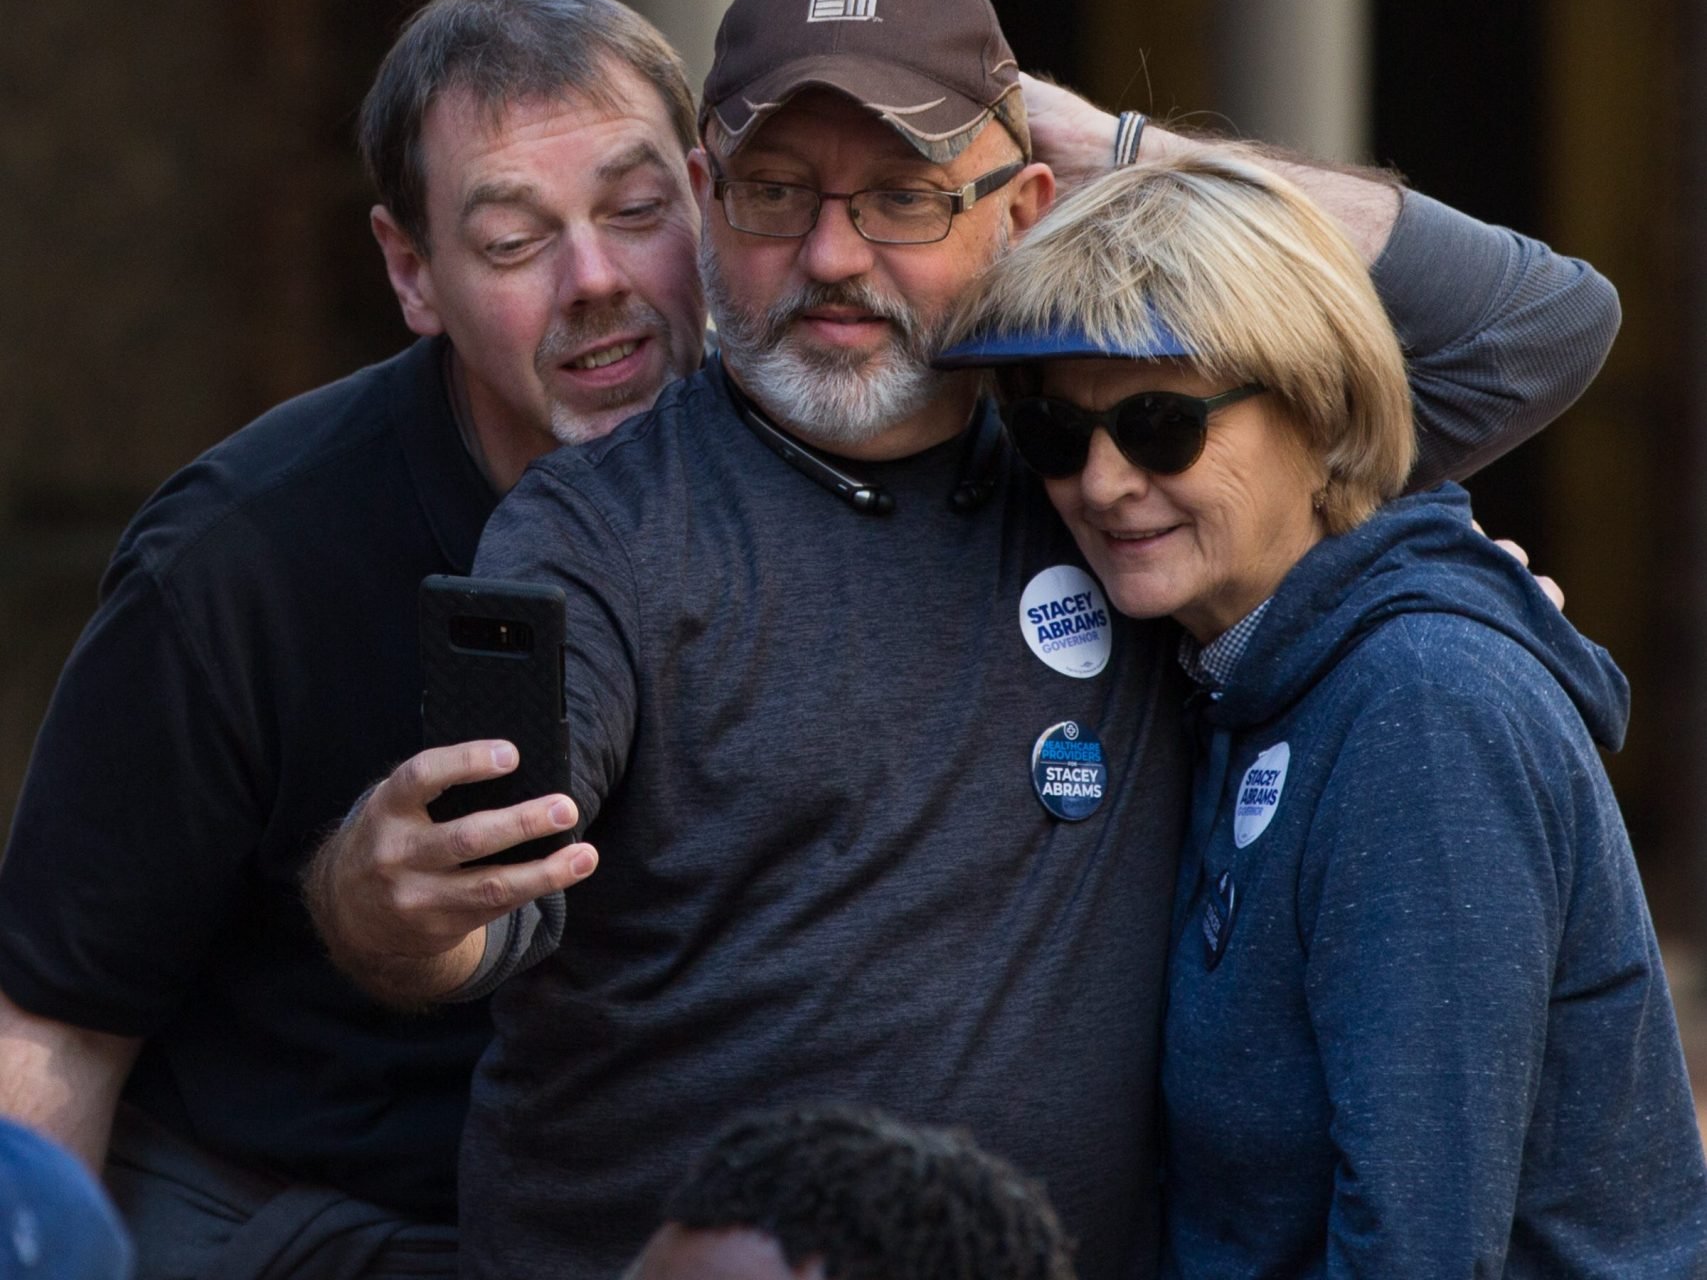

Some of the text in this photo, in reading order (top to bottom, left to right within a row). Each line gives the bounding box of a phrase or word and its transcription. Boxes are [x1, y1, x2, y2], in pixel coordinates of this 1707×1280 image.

[1027, 591, 1093, 625] STACEY
[1037, 609, 1108, 644] ABRAMS
[1042, 631, 1100, 654] GOVERNOR
[1041, 750, 1101, 762] PROVIDERS
[1046, 767, 1098, 783] STACEY
[1246, 769, 1281, 787] STACEY
[1042, 782, 1102, 798] ABRAMS
[1240, 787, 1278, 806] ABRAMS
